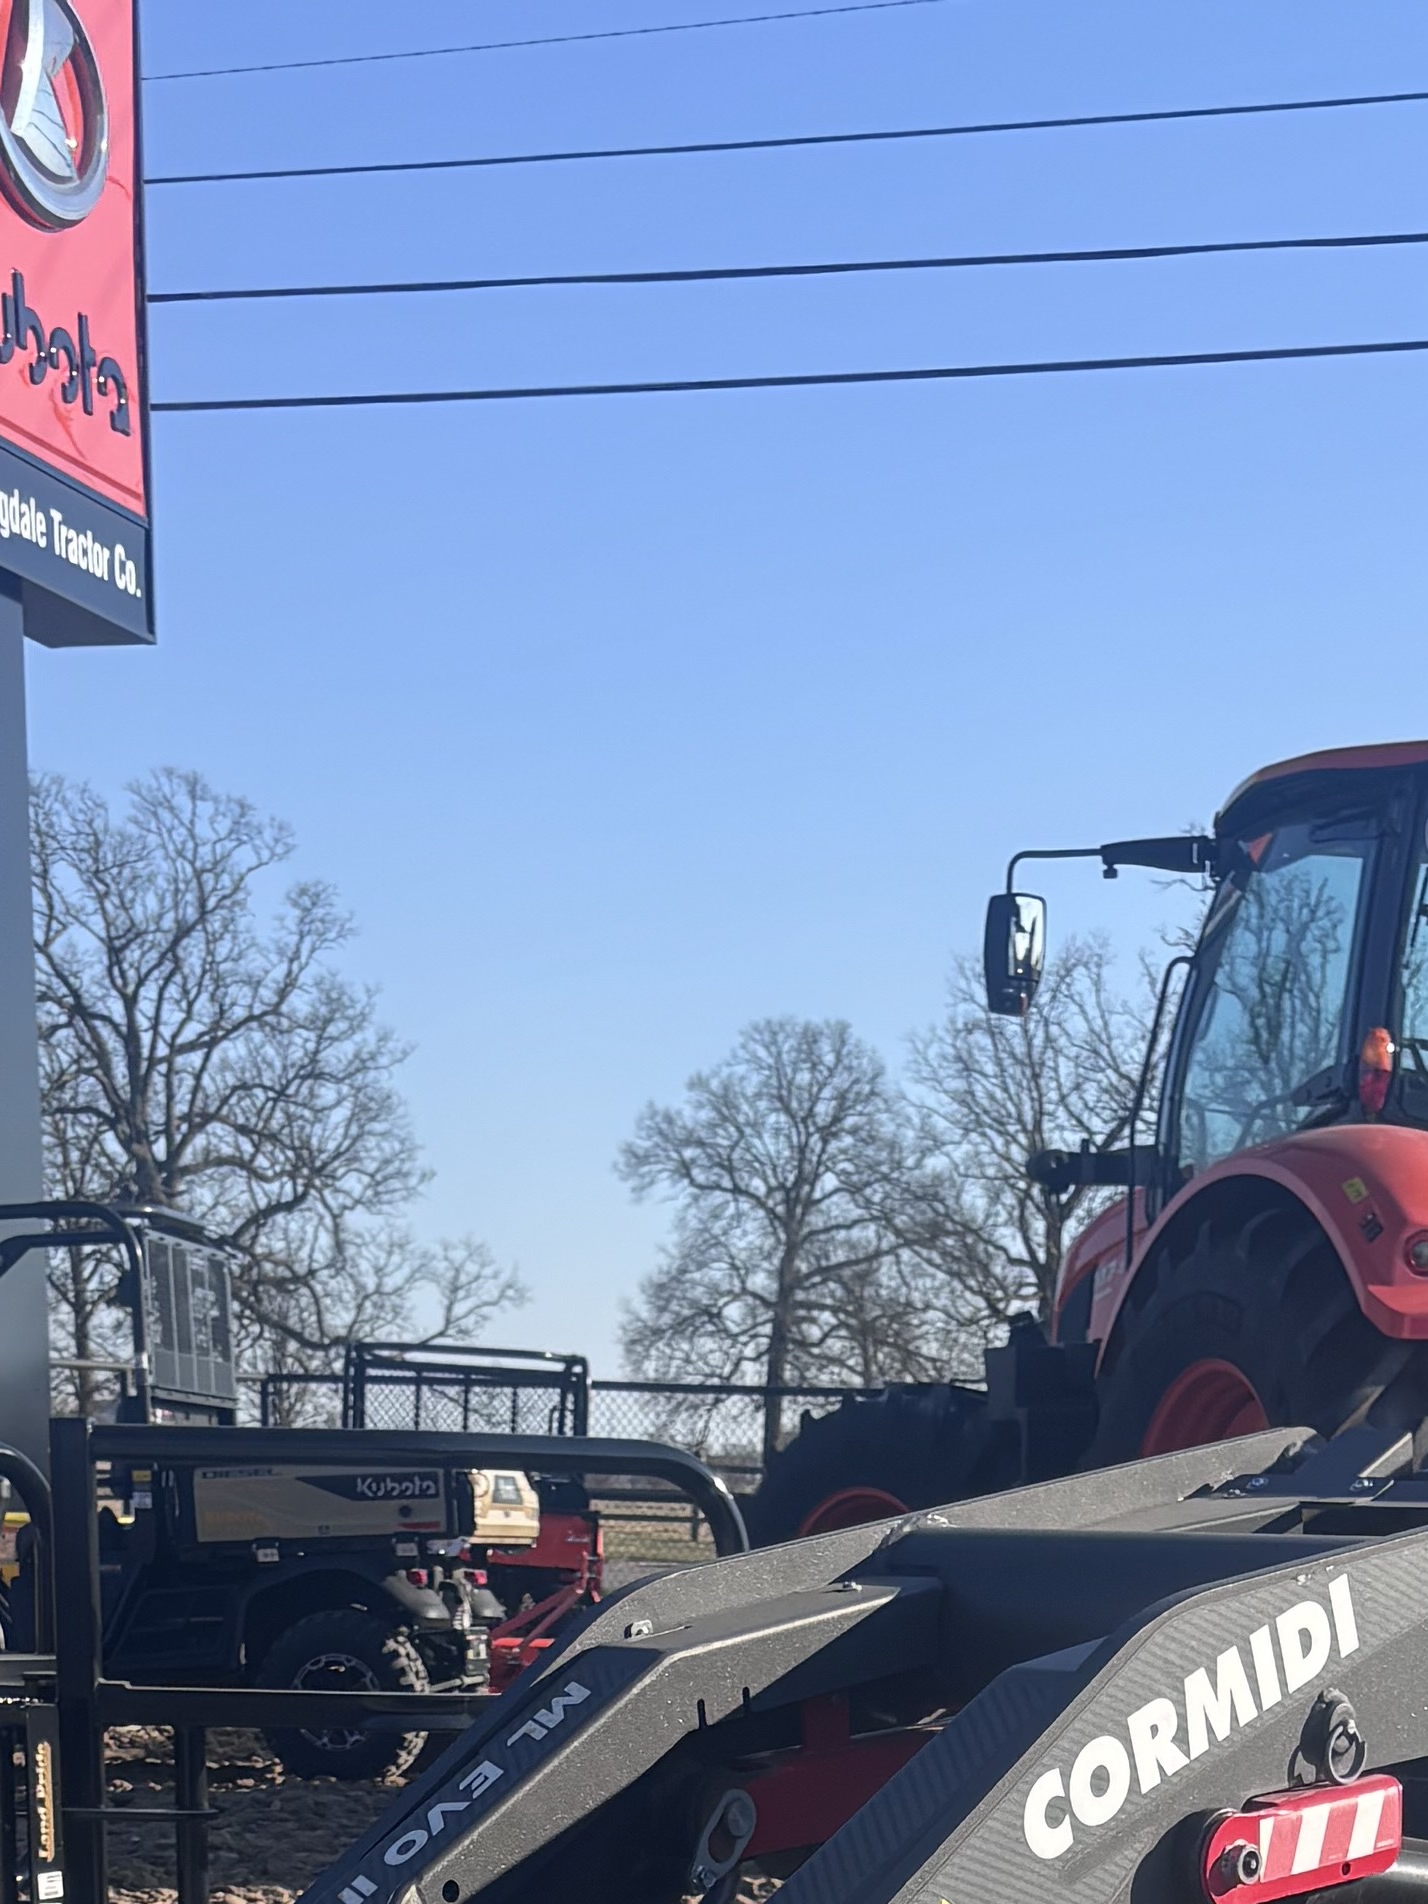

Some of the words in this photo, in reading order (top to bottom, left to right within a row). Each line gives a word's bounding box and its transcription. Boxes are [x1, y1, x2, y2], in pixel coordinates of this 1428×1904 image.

[50, 508, 111, 581] Tractor
[114, 546, 142, 598] Co.
[356, 1476, 438, 1497] Kubota
[506, 1681, 592, 1747] ML
[1023, 1573, 1360, 1860] CORMIDI
[383, 1760, 505, 1866] EVO
